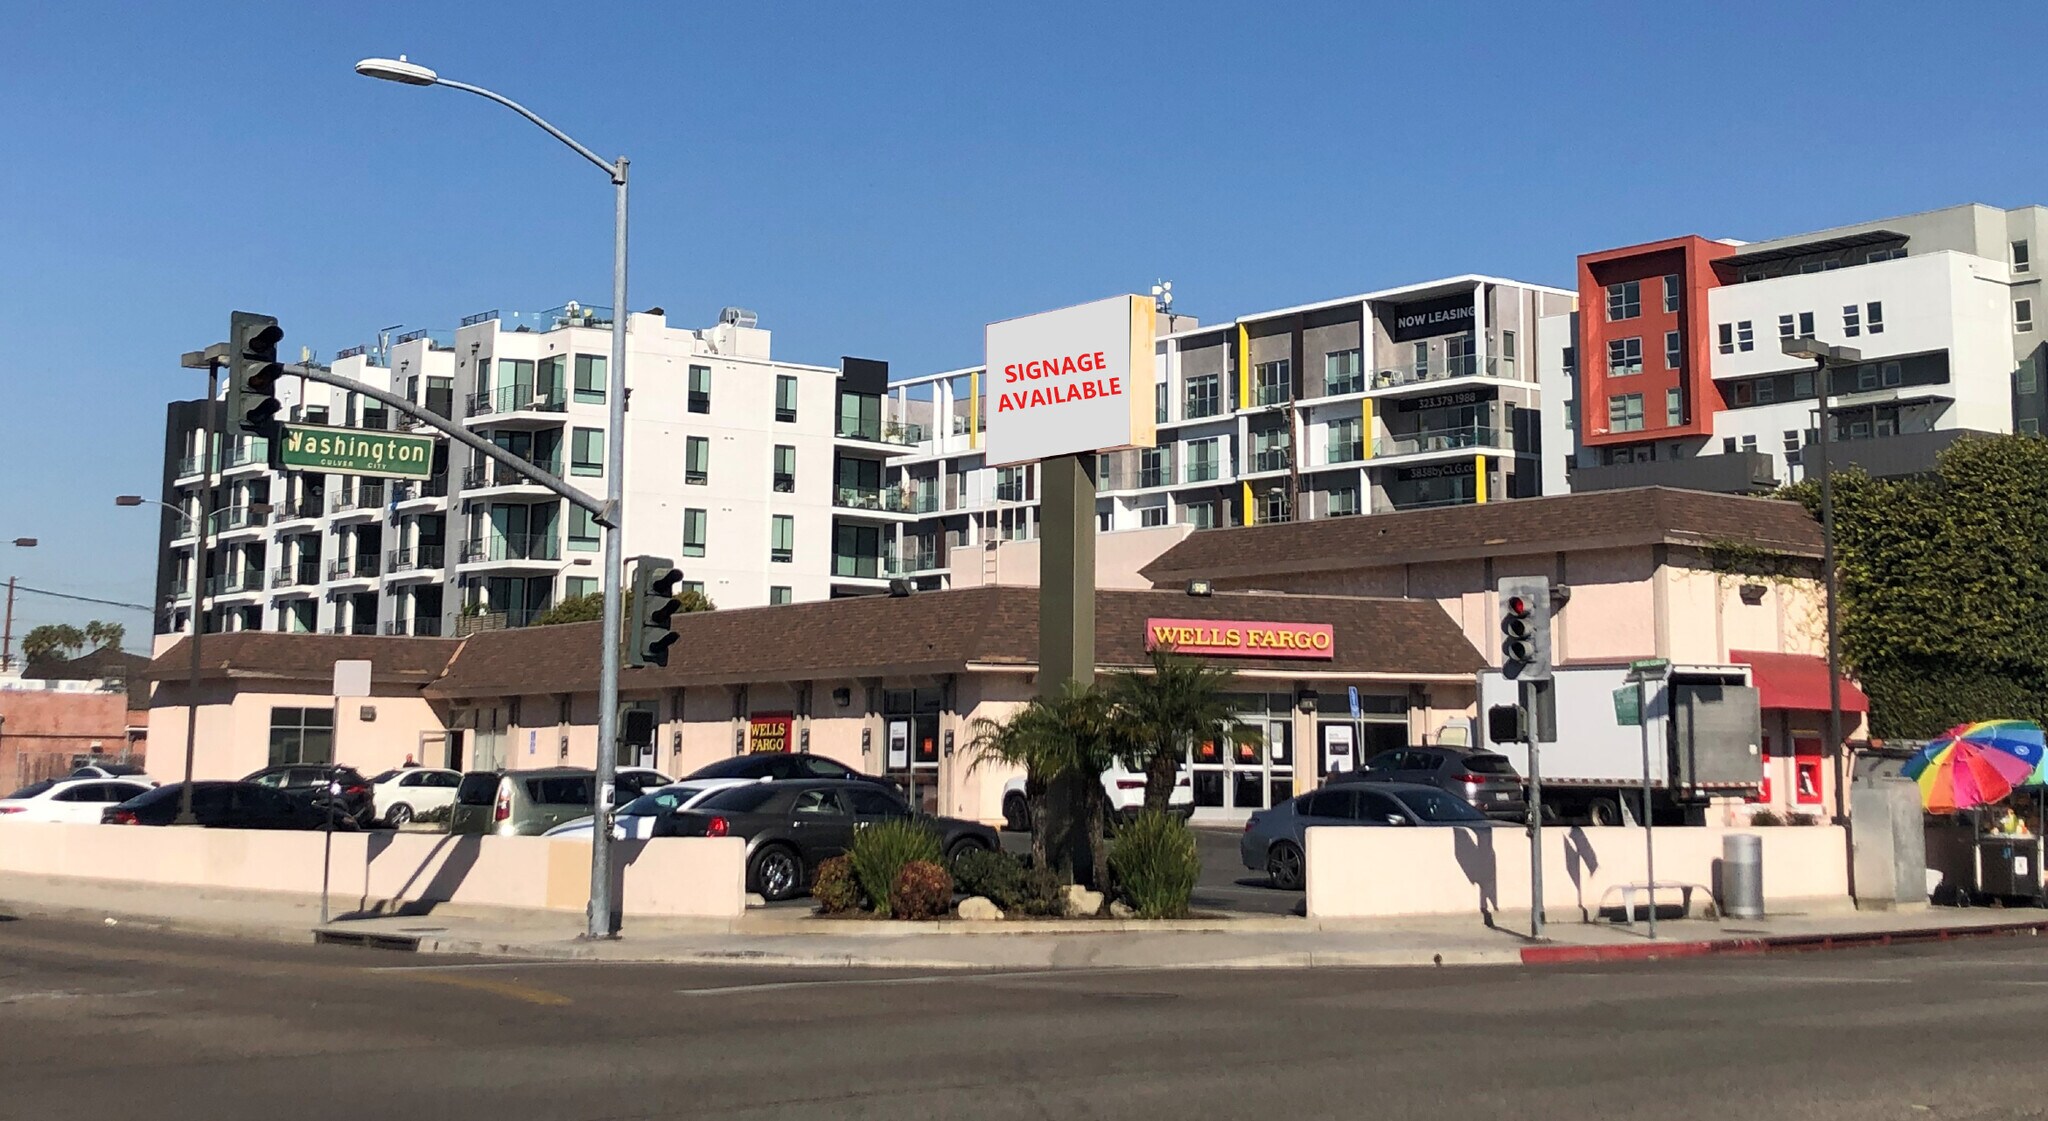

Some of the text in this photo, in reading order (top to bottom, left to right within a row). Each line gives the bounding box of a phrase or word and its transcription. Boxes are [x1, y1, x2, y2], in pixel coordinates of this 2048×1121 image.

[1398, 306, 1475, 328] NOW LEASING
[1004, 352, 1106, 383] SIGNAGE
[998, 377, 1122, 412] AVAILABLE
[1419, 392, 1476, 409] 323.379.1988
[288, 431, 424, 463] Washington
[320, 458, 387, 470] CULVER CITY
[1410, 463, 1475, 479] 3838byCLG.co
[1153, 626, 1330, 649] WELLS FARGO
[751, 723, 785, 736] WELLS
[751, 739, 784, 751] FARGO
